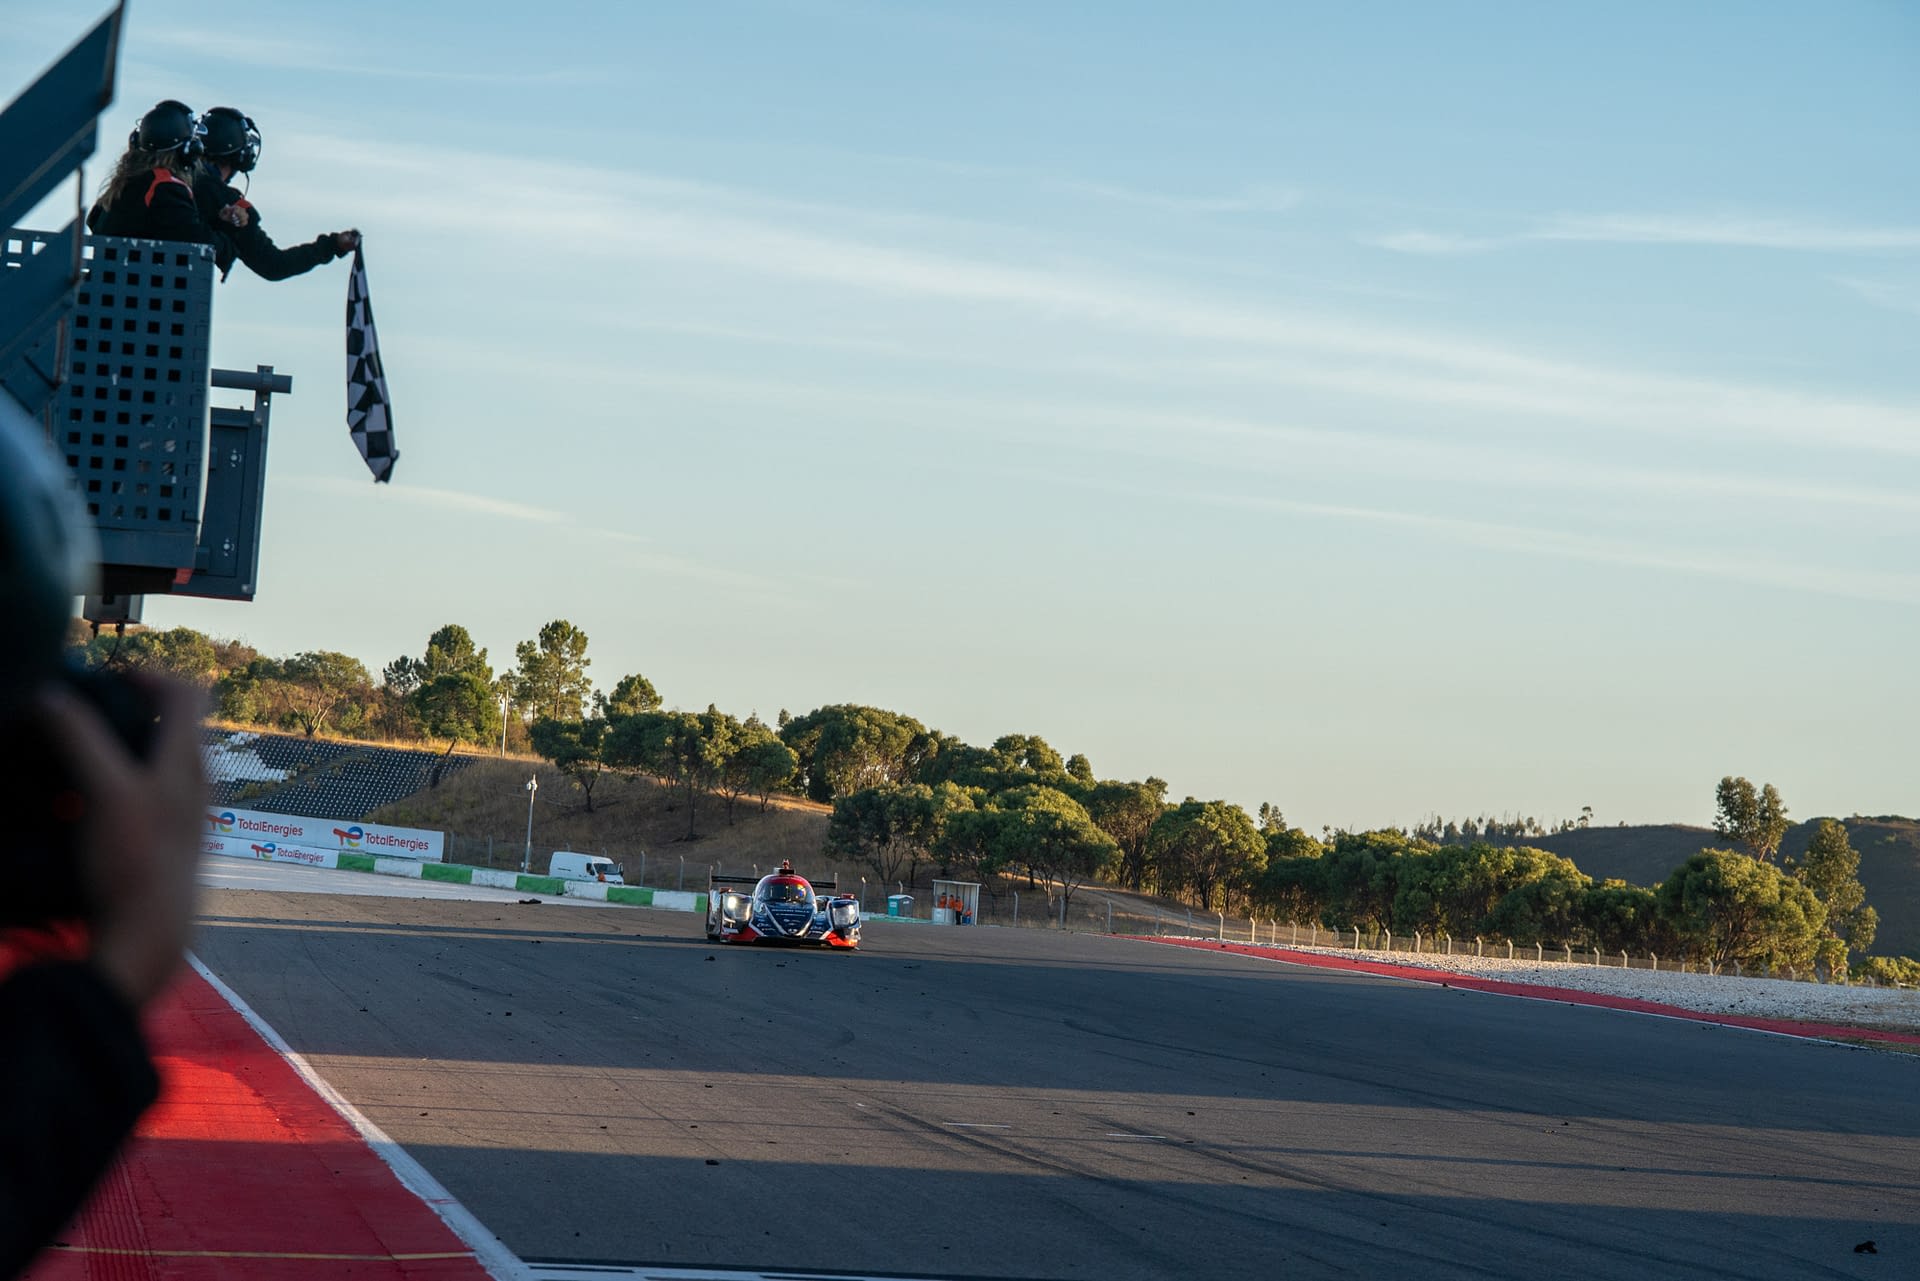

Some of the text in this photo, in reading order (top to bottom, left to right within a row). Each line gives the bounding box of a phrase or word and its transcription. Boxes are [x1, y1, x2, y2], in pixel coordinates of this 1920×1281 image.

[237, 818, 303, 837] TotalEnergies
[365, 832, 429, 852] TotalEnergies
[277, 847, 324, 863] TotalEnergies
